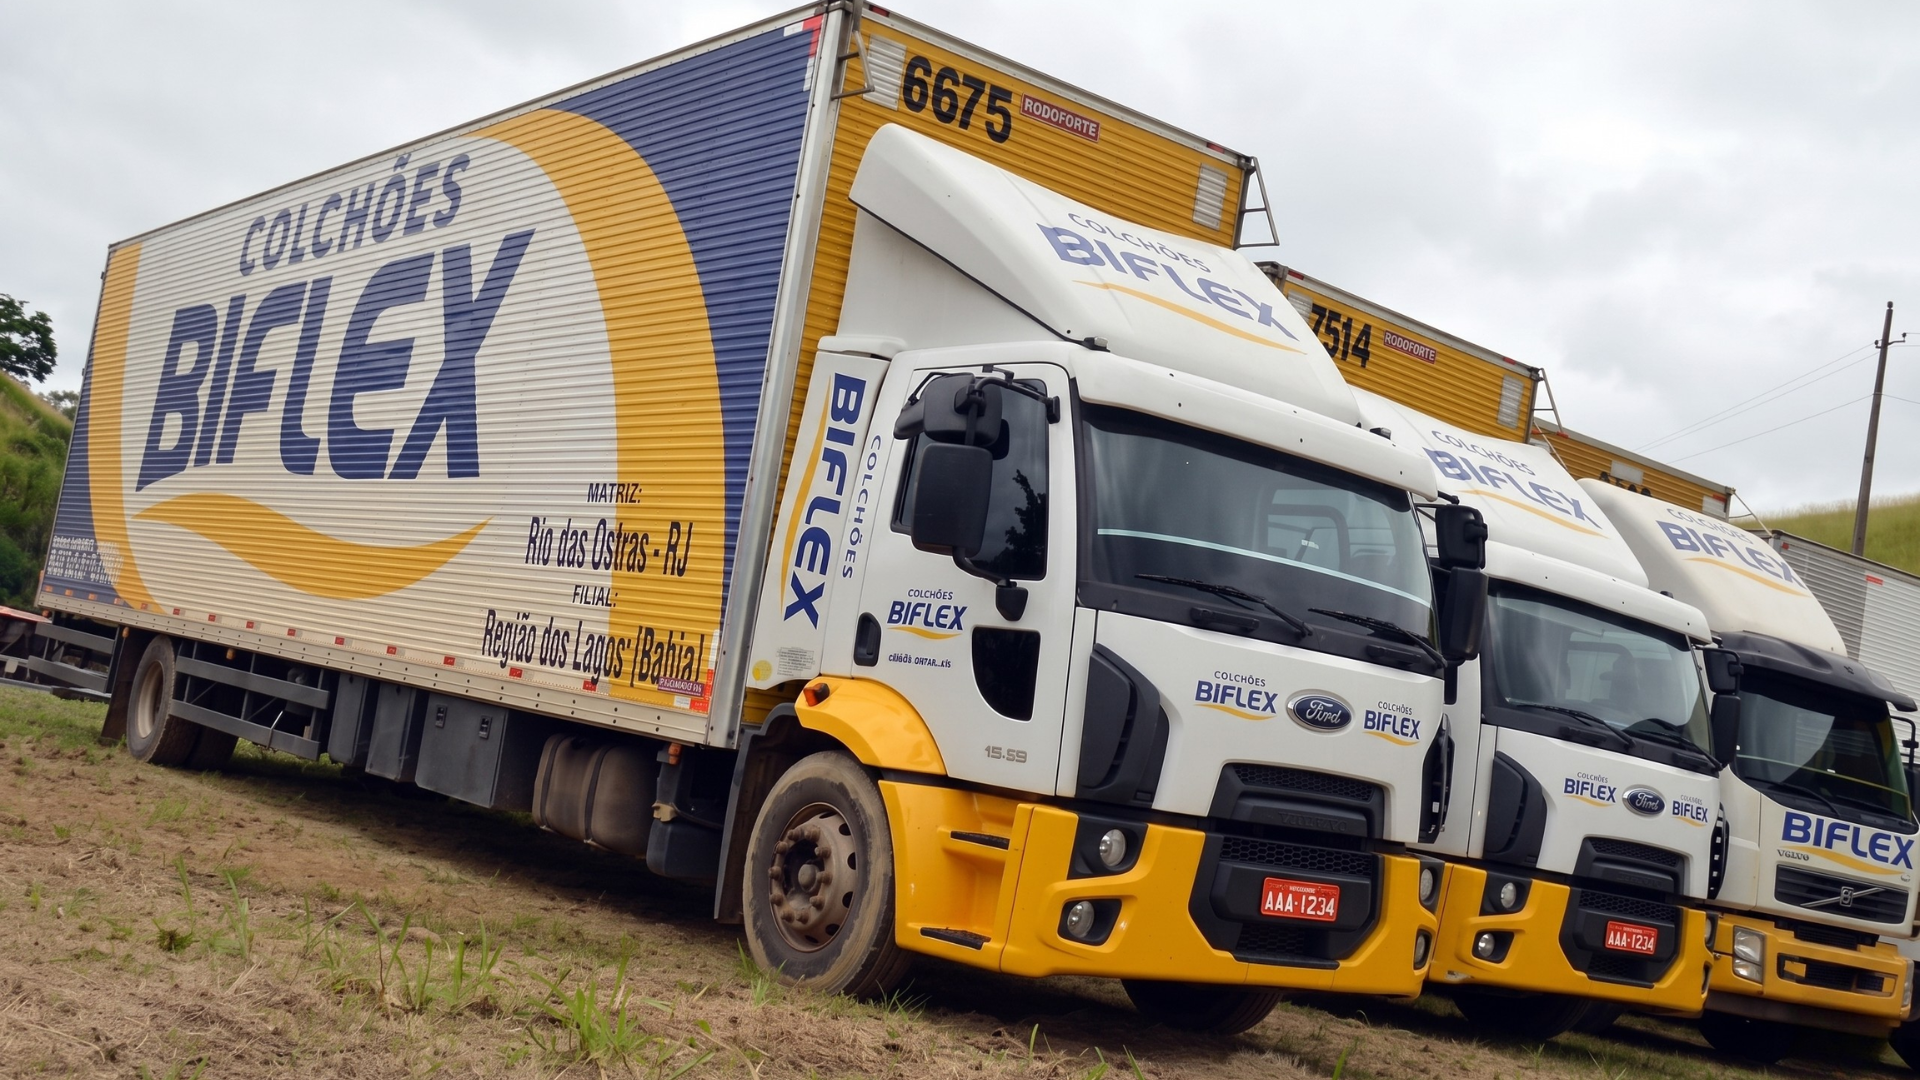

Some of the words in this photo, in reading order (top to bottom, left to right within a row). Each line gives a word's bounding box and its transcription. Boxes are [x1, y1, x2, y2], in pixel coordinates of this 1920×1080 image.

[903, 55, 1012, 144] 6675
[1024, 98, 1097, 137] RODOFORTE
[239, 152, 471, 277] COLCHÕES
[1036, 223, 1300, 342] BIFLEX
[135, 228, 536, 492] BIFLEX
[1311, 303, 1372, 368] 7514
[1385, 332, 1436, 361] RODOFORTE
[586, 483, 642, 503] MATRIZ:
[784, 372, 866, 629] BIFLEX
[842, 435, 882, 579] COLCHÕES
[1422, 447, 1602, 530] BIFLEX
[525, 516, 553, 566] Rio
[556, 518, 588, 568] das
[591, 518, 649, 573] Ostras
[653, 549, 660, 557] -
[663, 521, 693, 577] RJ
[1655, 519, 1807, 590] BIFLEX
[572, 585, 618, 608] FILIAL:
[887, 601, 968, 631] BIFLEX
[481, 609, 536, 669] Região
[540, 616, 570, 669] dos
[1195, 680, 1278, 714] BIFLEX
[1363, 710, 1420, 740] BIFLEX
[1563, 778, 1616, 803] BIFLEX
[1672, 800, 1708, 823] BIFLEX
[1781, 811, 1914, 870] BIFLEX
